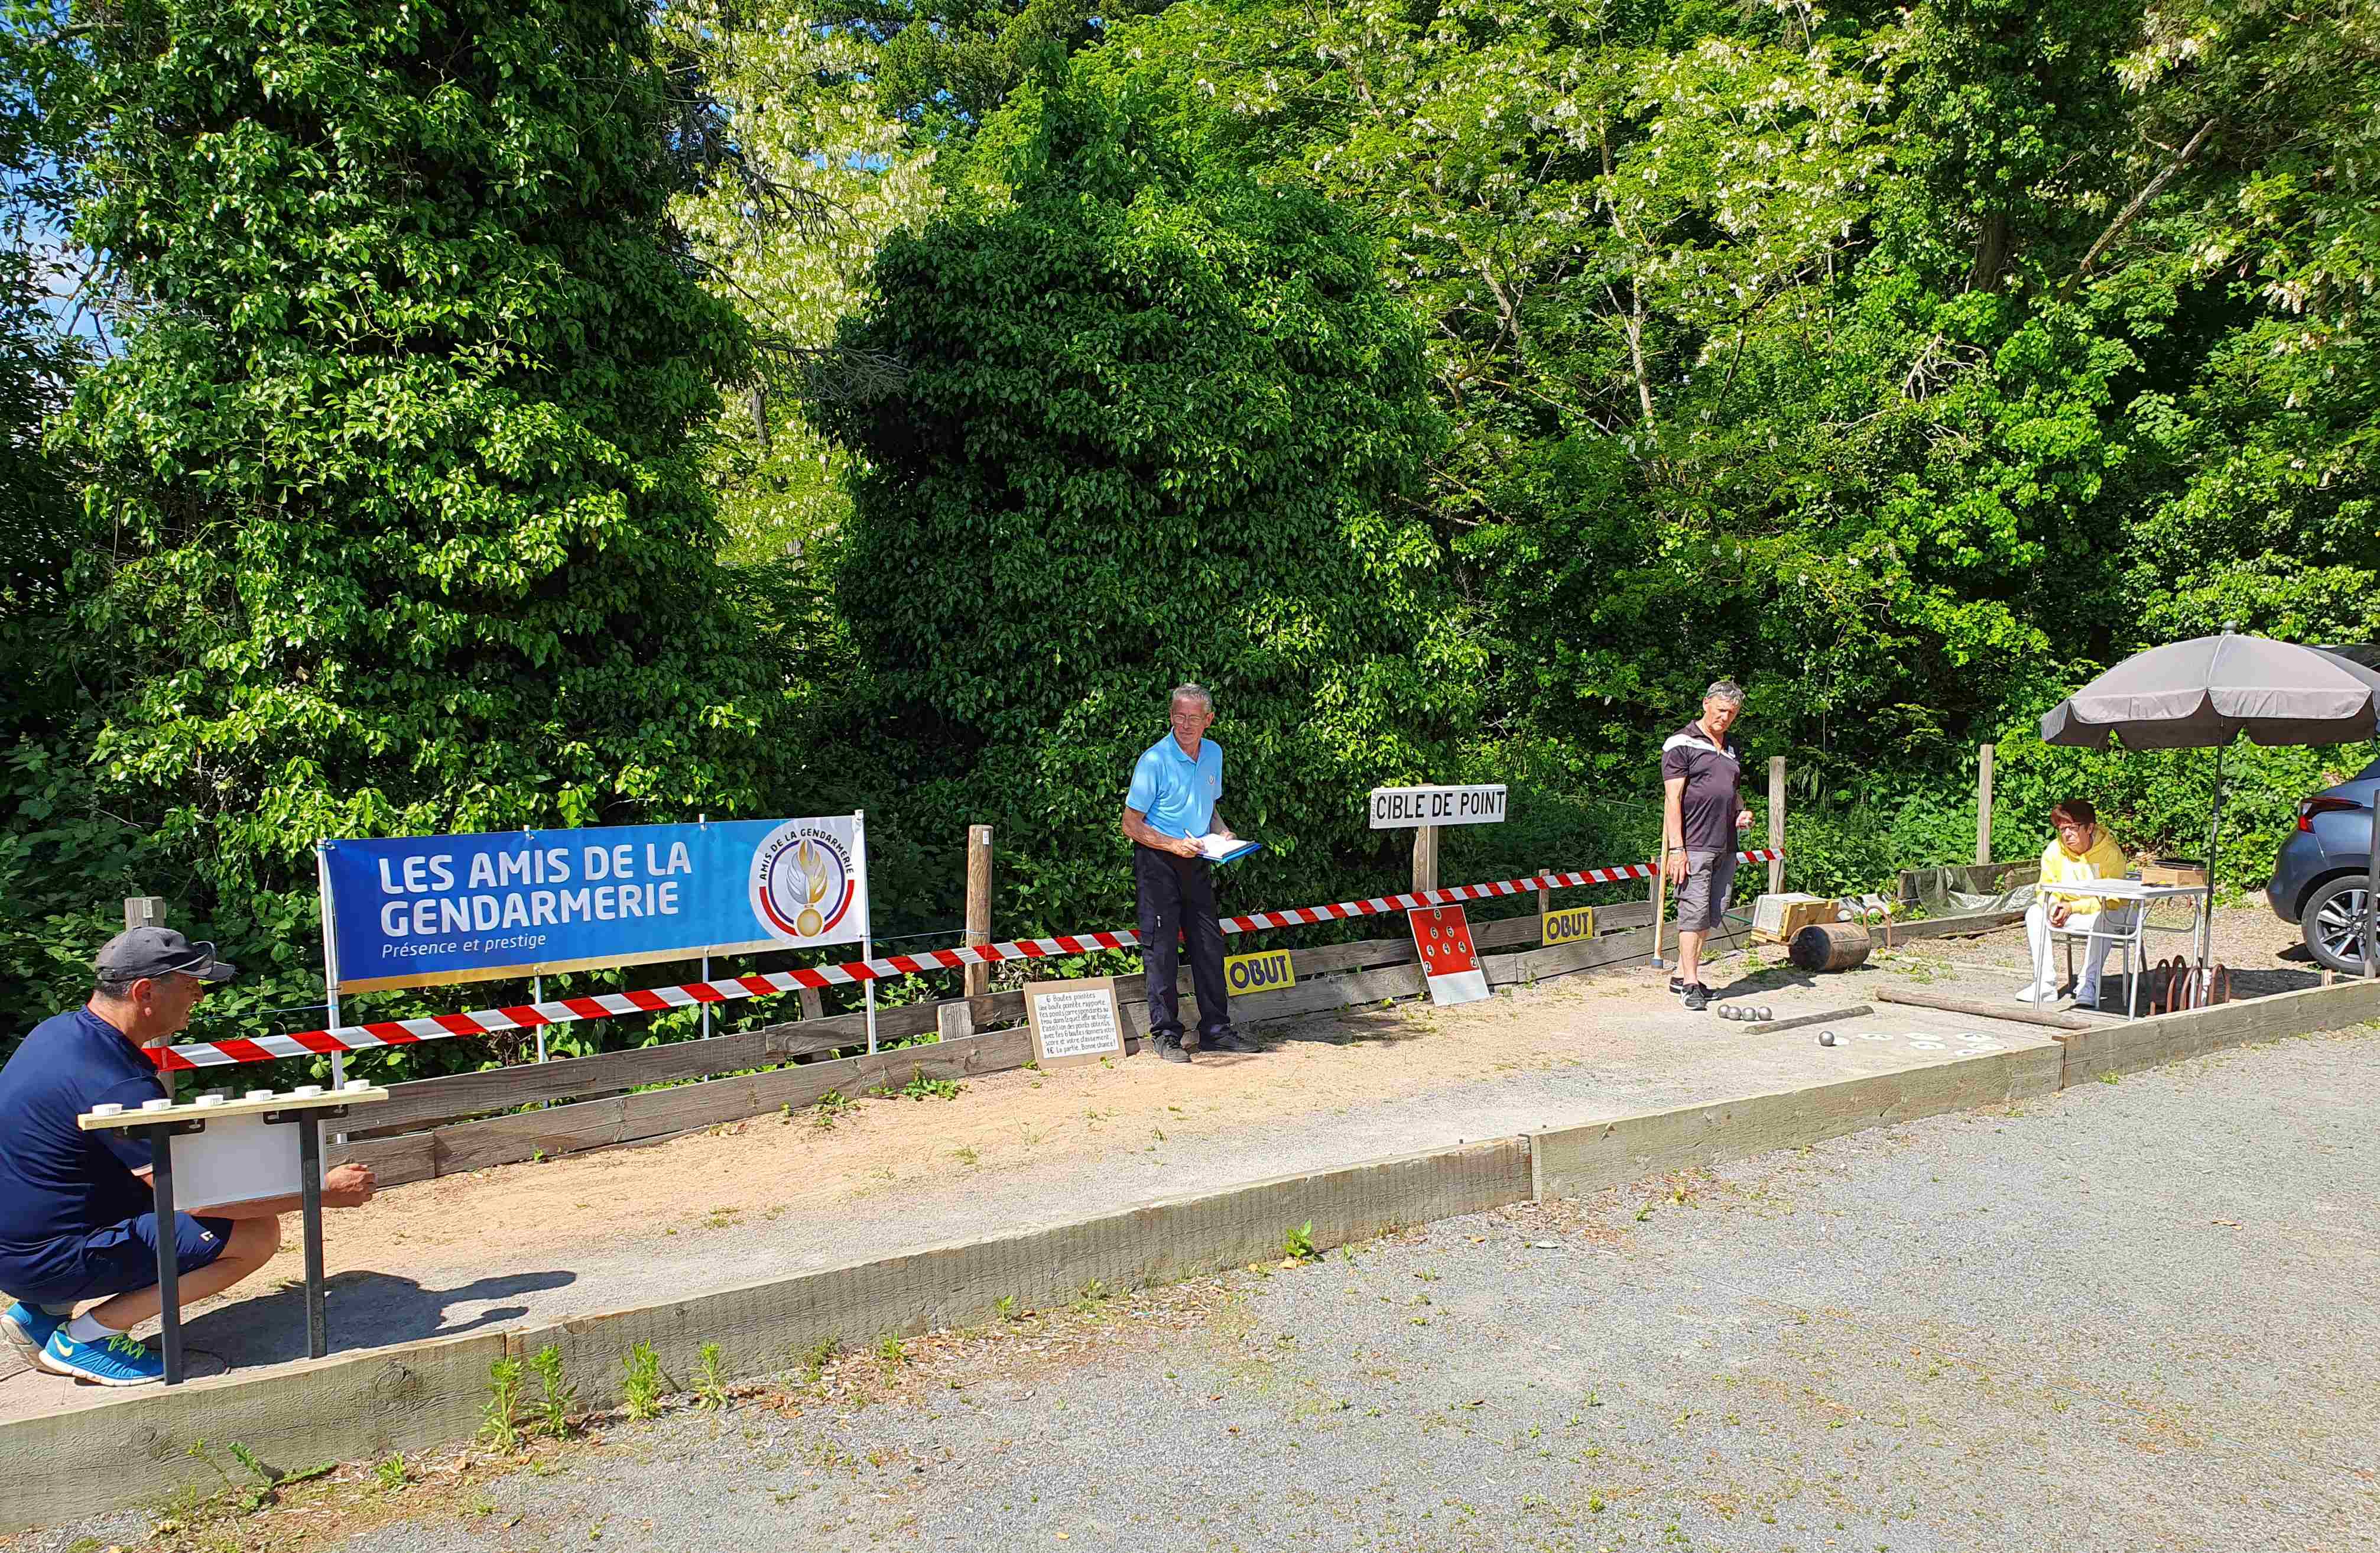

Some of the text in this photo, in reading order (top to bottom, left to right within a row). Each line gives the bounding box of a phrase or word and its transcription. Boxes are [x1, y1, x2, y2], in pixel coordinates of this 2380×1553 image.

[1376, 794, 1426, 819] CIBLE
[1432, 793, 1453, 817] DE
[1460, 791, 1505, 815] POINT
[378, 841, 692, 894] LES AMIS DE LA
[759, 828, 855, 880] AMIS DE LA GENDARMERIE
[380, 881, 679, 938] GENDARMERIE
[1435, 909, 1440, 918] 8
[1431, 928, 1437, 936] 6
[1547, 912, 1589, 939] OBUT
[381, 932, 546, 959] Présence et prestige
[1427, 942, 1465, 957] 4 4 4
[1230, 955, 1288, 988] OBUT
[1425, 958, 1477, 971] 2 2
[1053, 994, 1072, 1002] Boules
